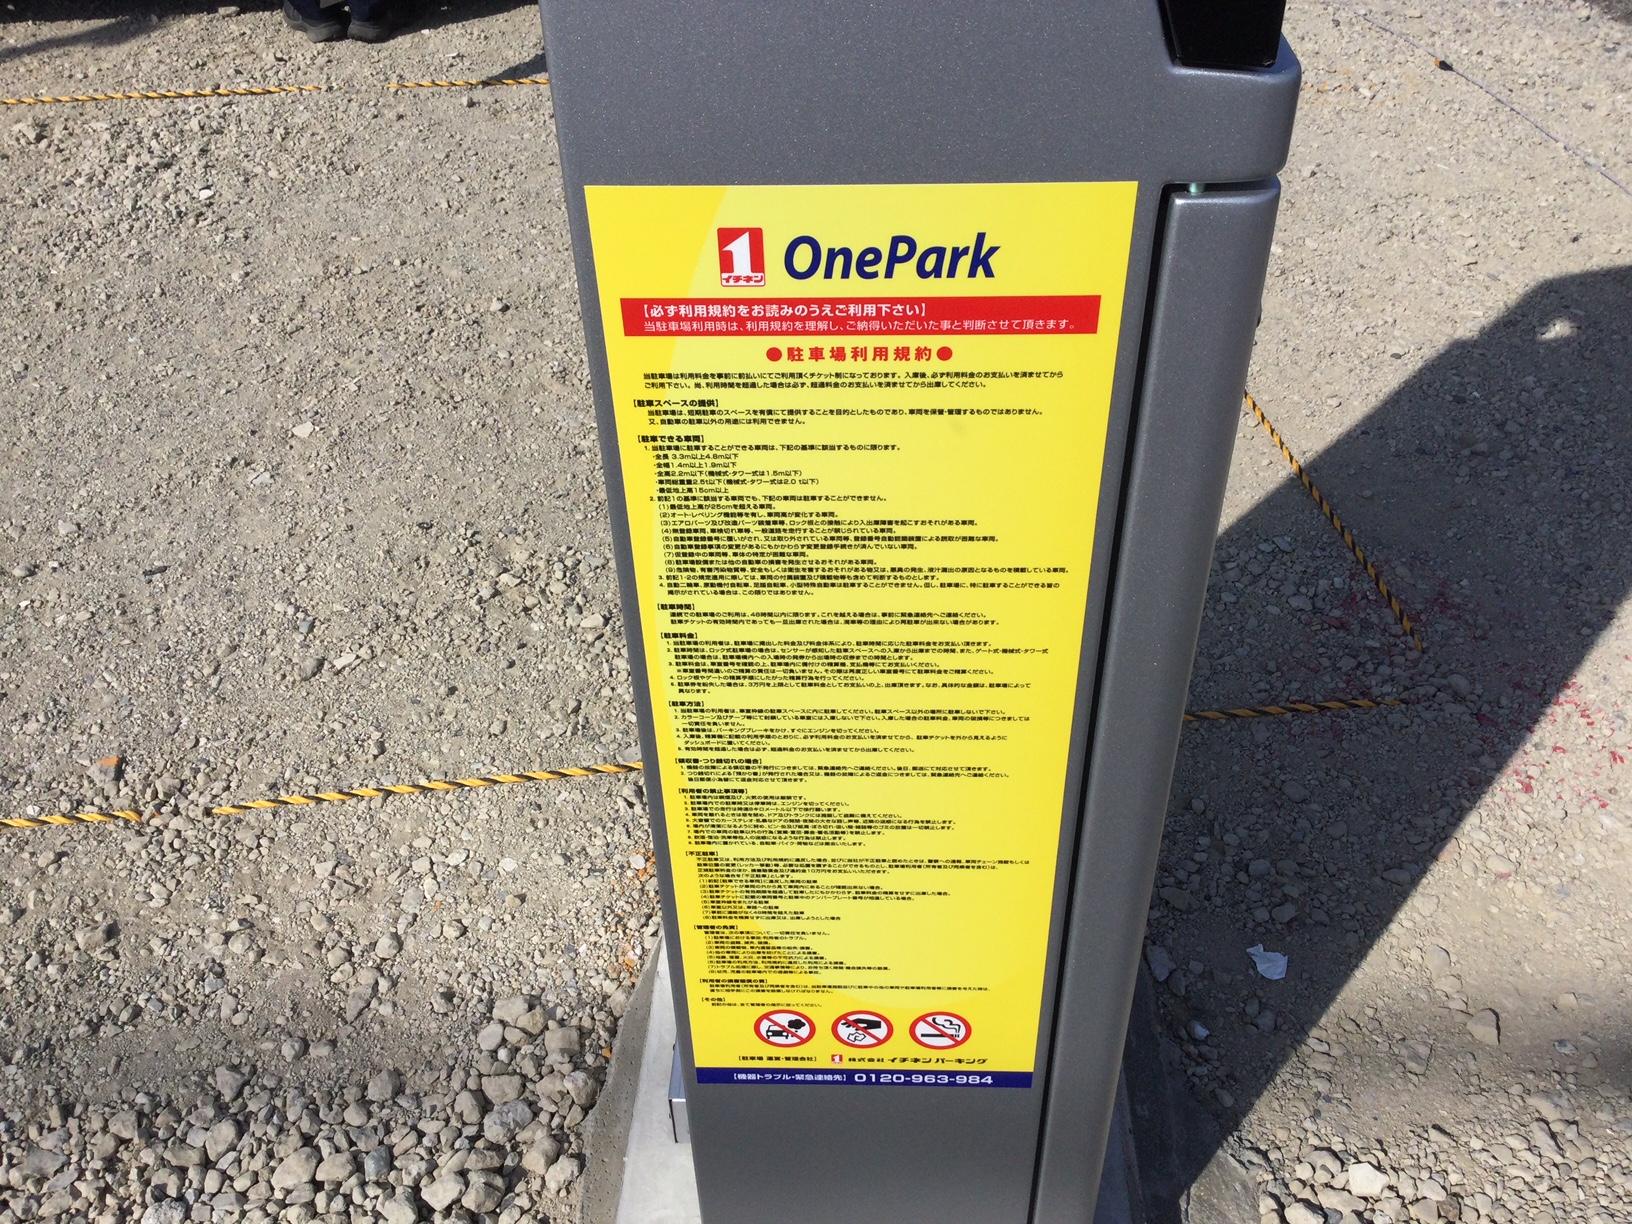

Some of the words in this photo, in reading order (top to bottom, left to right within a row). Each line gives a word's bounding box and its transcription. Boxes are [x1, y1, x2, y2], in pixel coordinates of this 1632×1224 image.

[784, 232, 1002, 280] OnePark
[722, 273, 764, 285] イチネン
[643, 303, 927, 319] 【必ず利用規約をお読みのうえご利用下さい】
[854, 1073, 994, 1085] 0120-963-984
